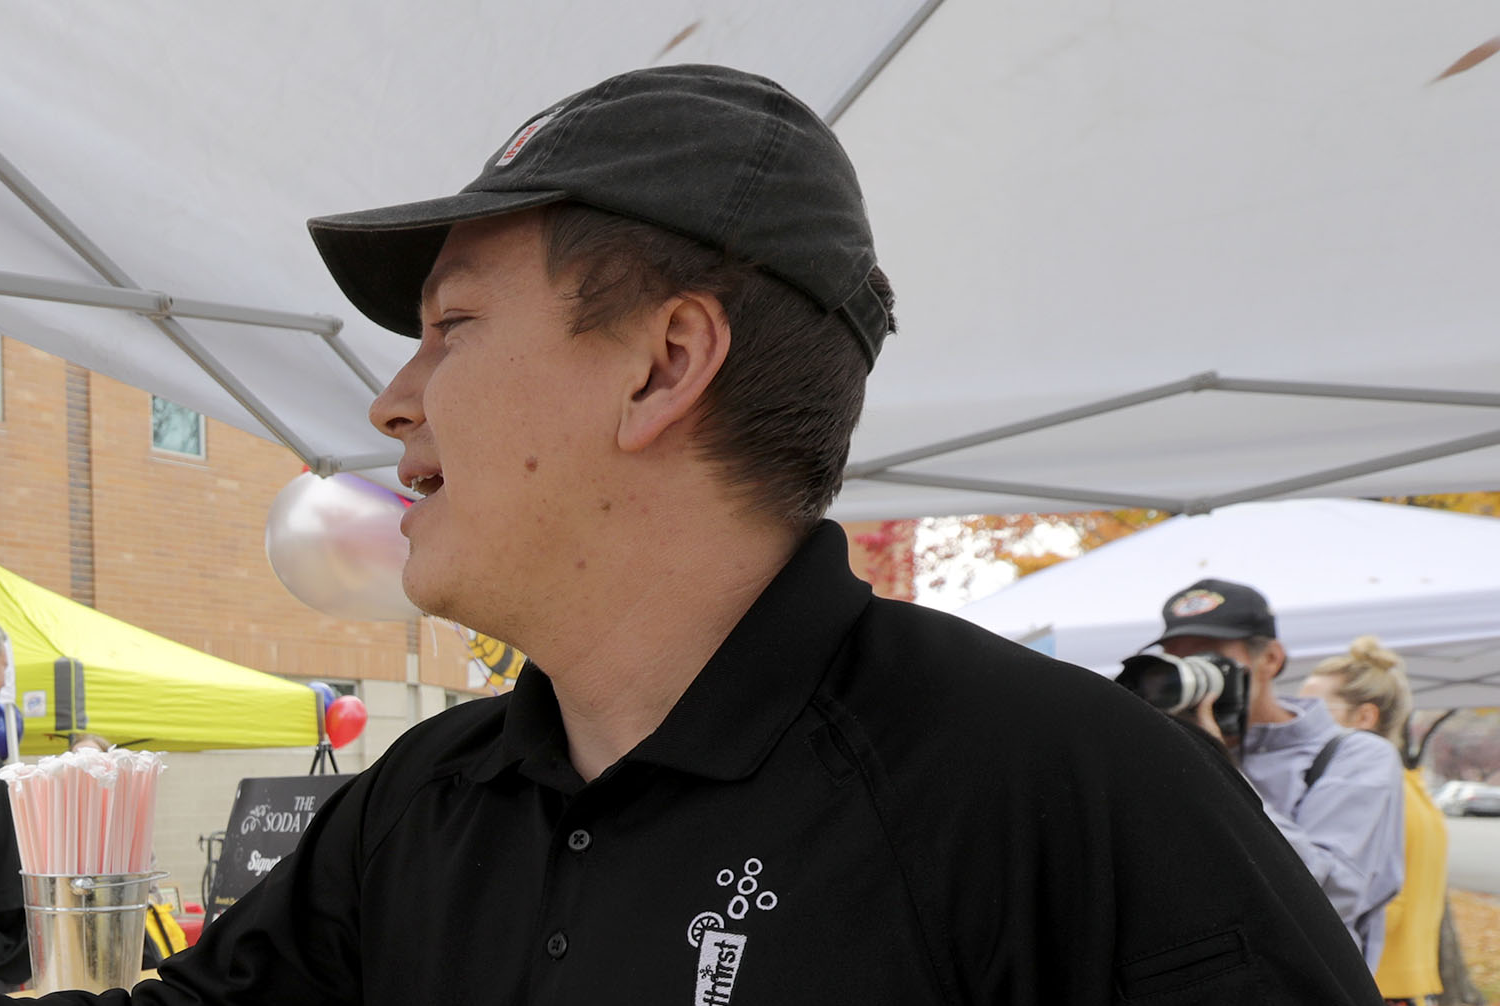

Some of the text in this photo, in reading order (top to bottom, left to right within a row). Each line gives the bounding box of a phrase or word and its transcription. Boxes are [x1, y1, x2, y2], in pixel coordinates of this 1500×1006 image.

[294, 795, 316, 812] THE
[262, 811, 301, 833] SODA
[701, 940, 739, 1006] thirst
